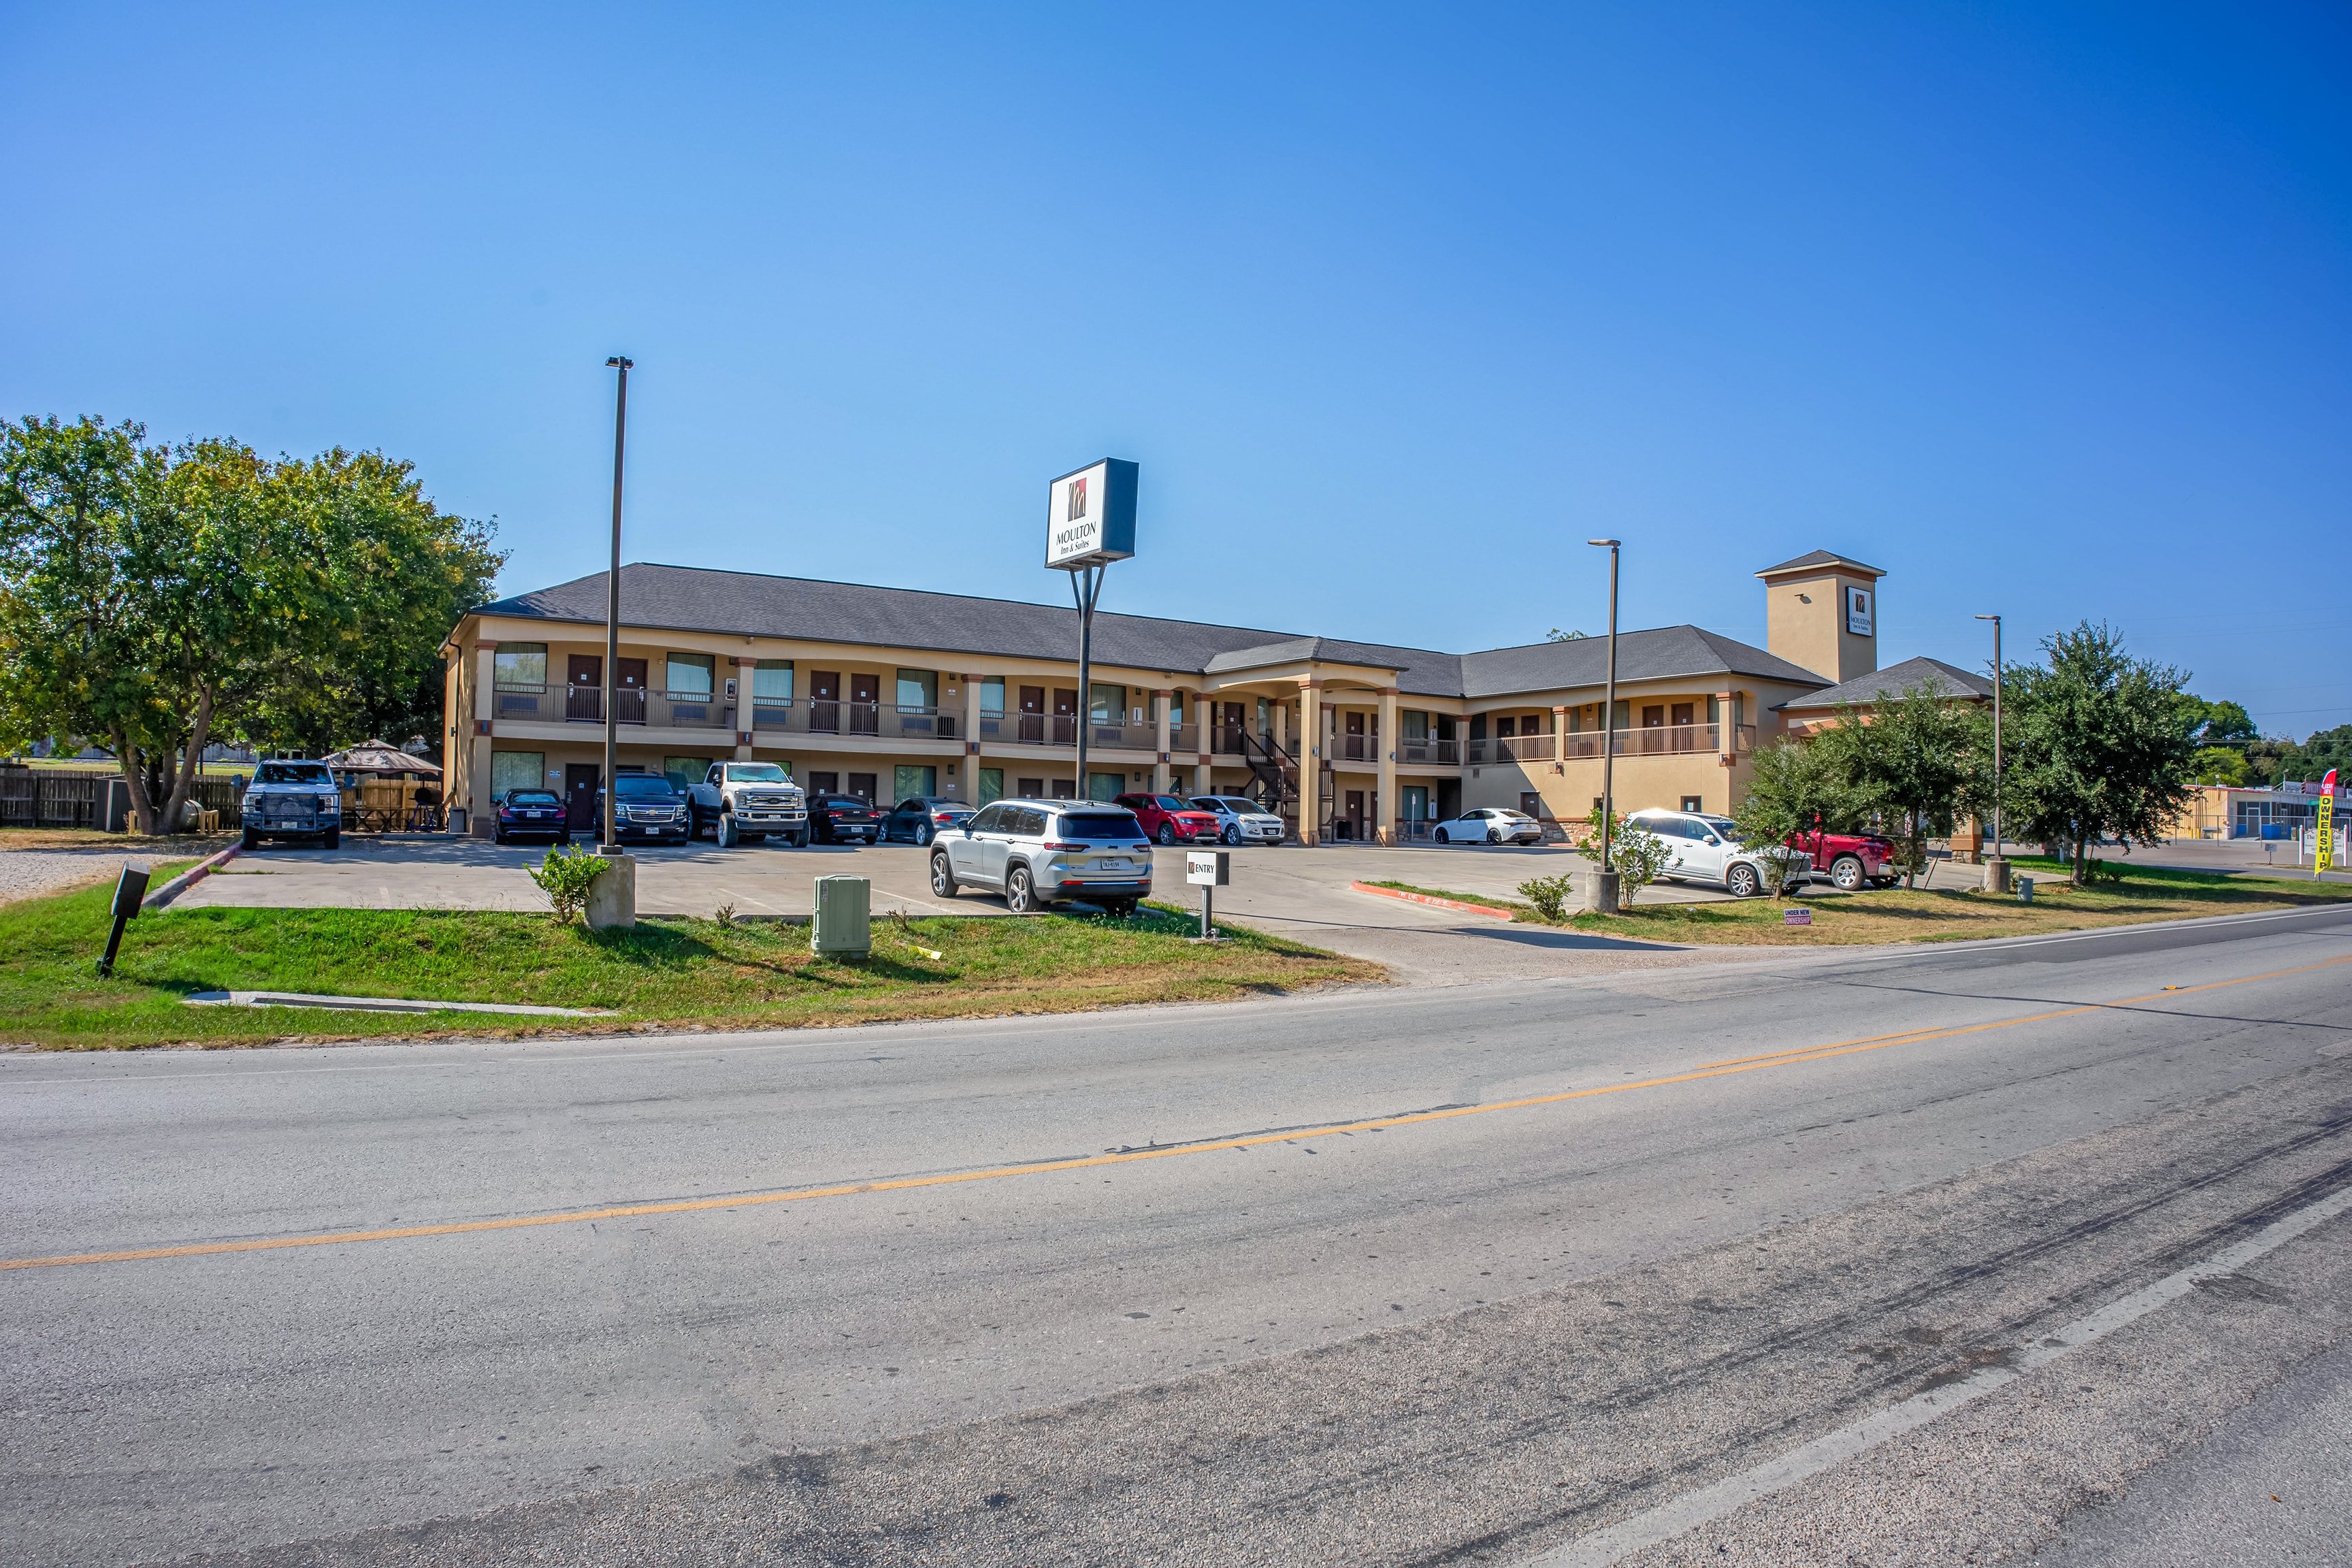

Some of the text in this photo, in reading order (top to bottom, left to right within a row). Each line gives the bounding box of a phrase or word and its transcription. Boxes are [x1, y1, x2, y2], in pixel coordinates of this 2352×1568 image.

[1056, 521, 1096, 545] MOULTON
[1075, 540, 1089, 551] Suites
[1850, 616, 1871, 626] MOULTON
[2319, 798, 2330, 869] OWNERSHIP
[1196, 864, 1214, 873] ENTRY
